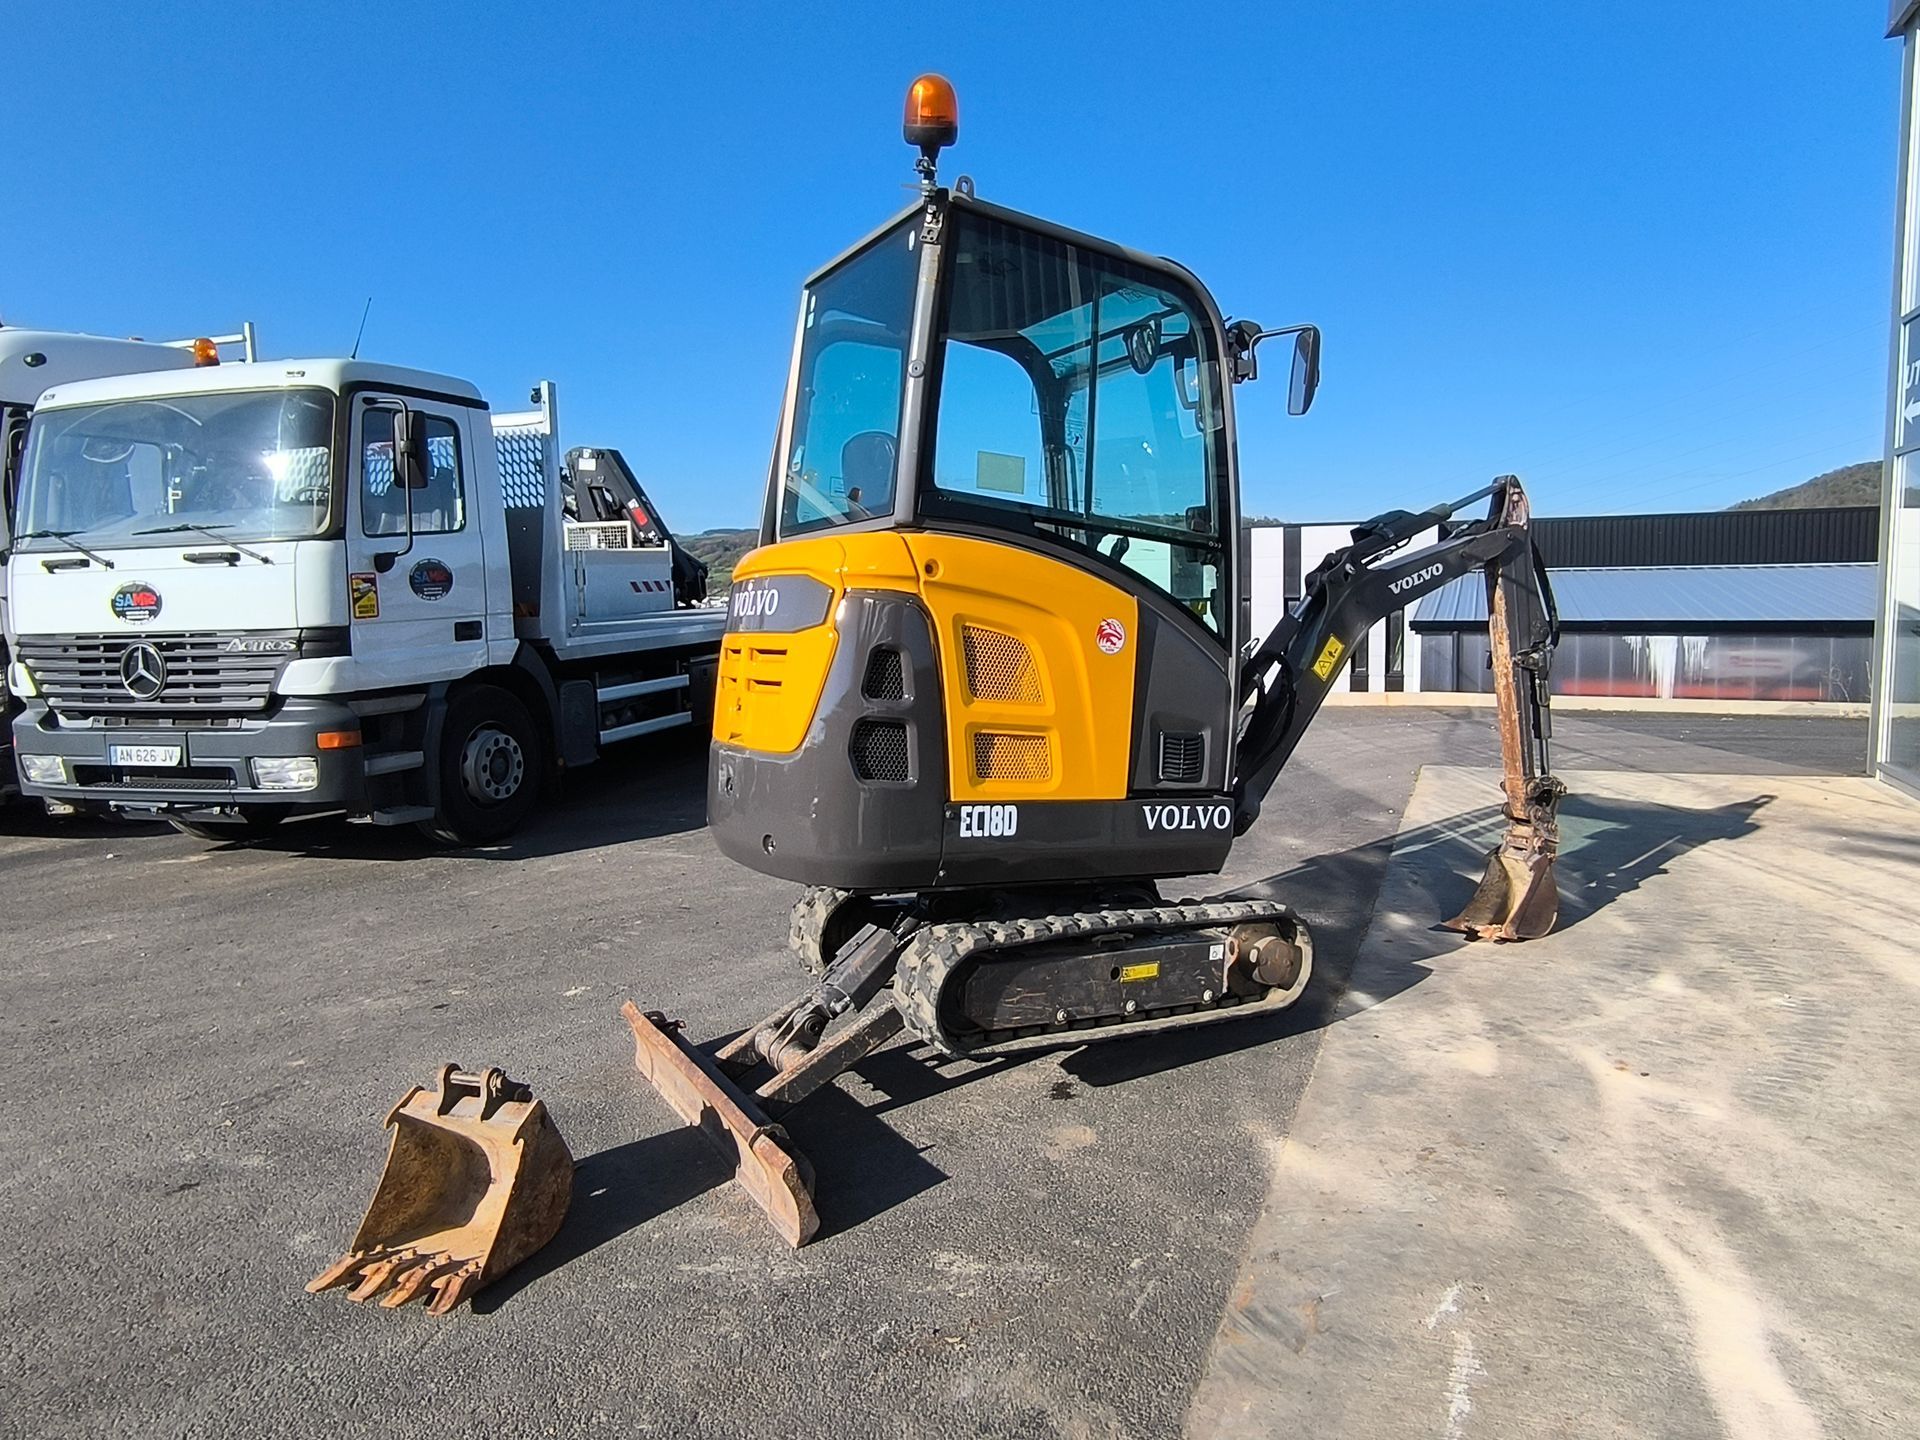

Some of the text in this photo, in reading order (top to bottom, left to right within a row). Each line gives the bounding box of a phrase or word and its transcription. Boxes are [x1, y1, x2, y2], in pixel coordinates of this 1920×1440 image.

[1388, 563, 1443, 595] VOLVO
[734, 589, 779, 617] VOLVO
[120, 749, 174, 763] AN 626 JV
[960, 805, 1018, 838] EC18D
[1142, 805, 1231, 830] VOLVO
